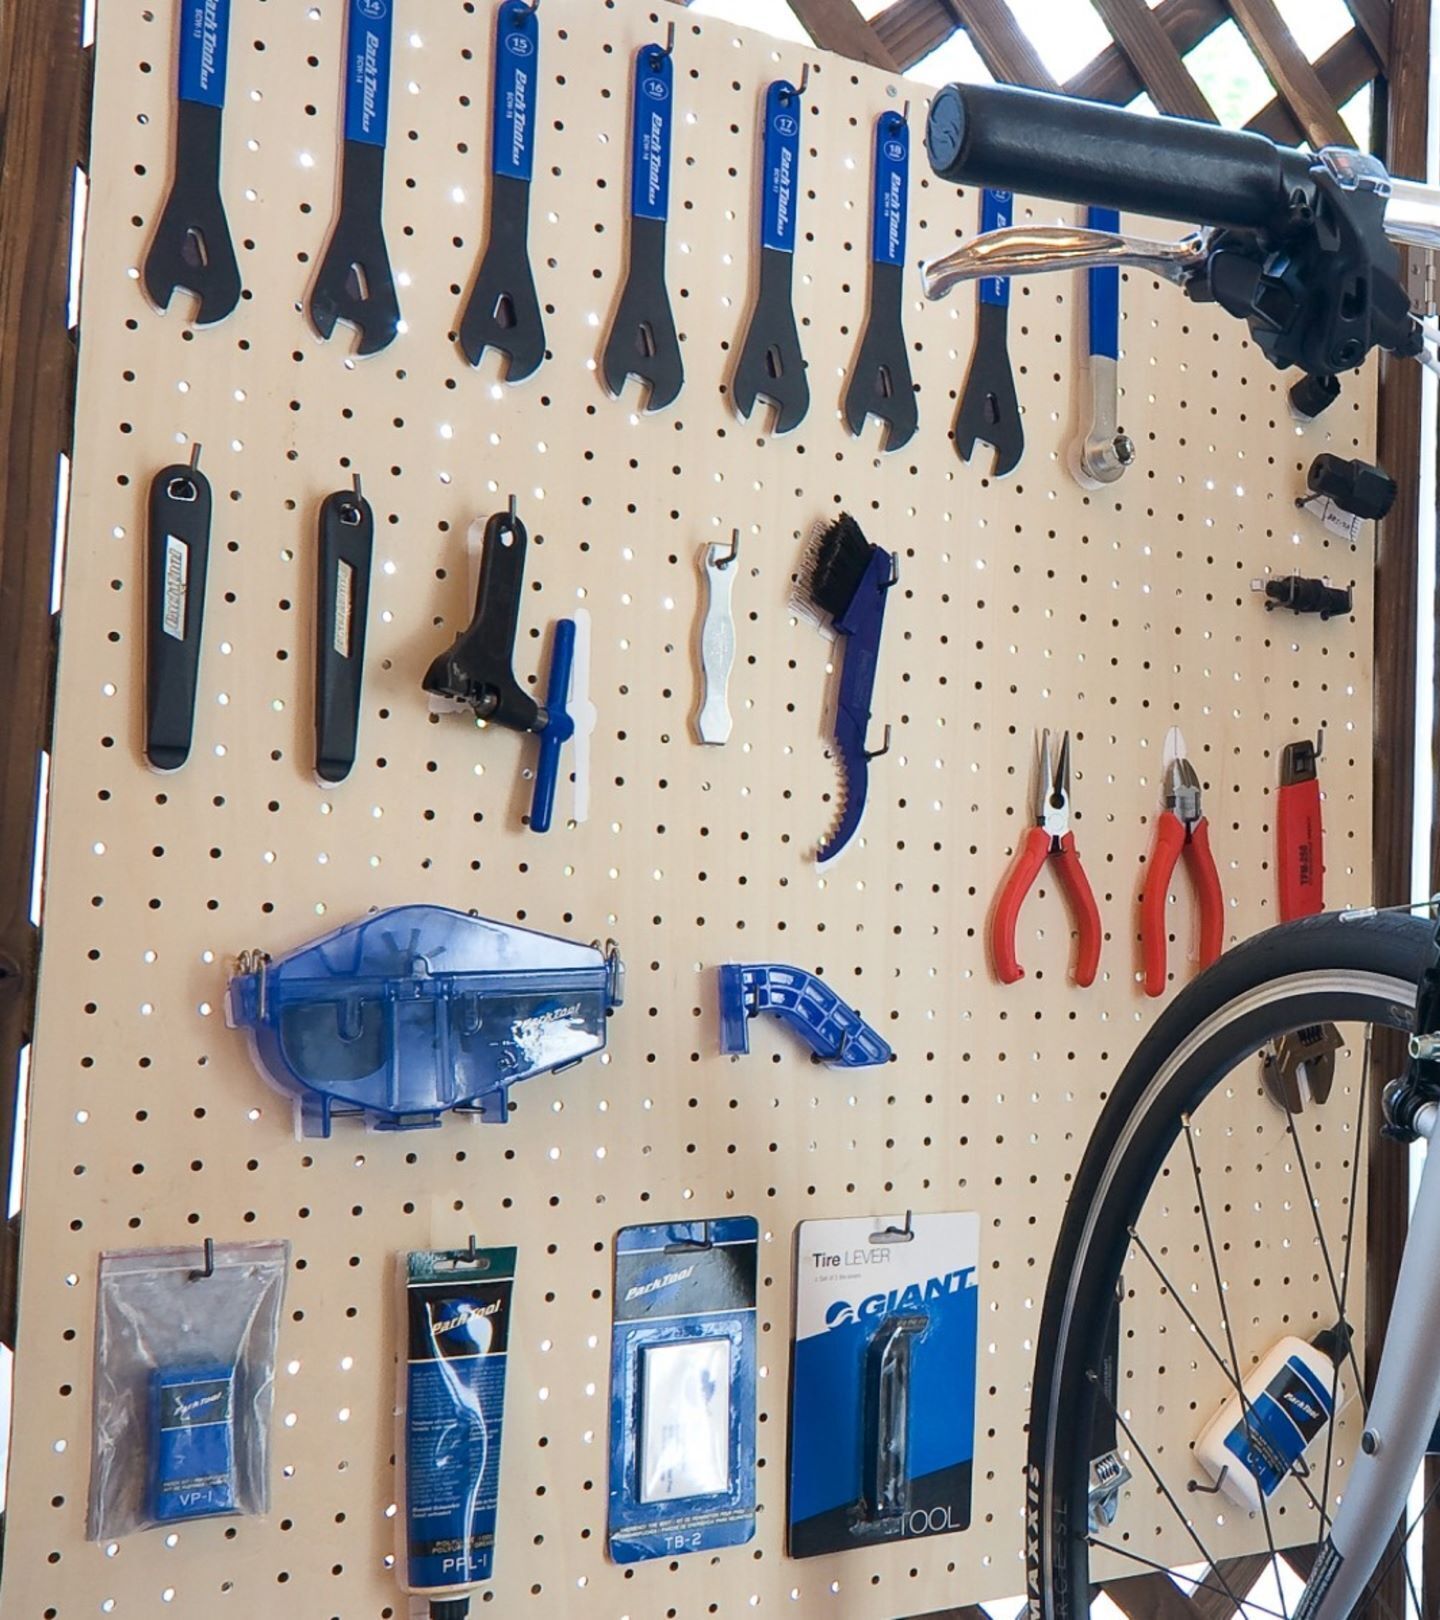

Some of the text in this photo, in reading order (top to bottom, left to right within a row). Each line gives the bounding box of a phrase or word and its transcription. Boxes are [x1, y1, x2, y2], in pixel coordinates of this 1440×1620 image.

[512, 38, 528, 49] 15
[649, 81, 664, 93] 16
[779, 118, 793, 130] 17
[888, 144, 902, 156] 18
[813, 1248, 891, 1268] Tire LEVER
[858, 1266, 977, 1322] GIANT
[179, 1490, 213, 1507] VP-1
[899, 1506, 961, 1536] TOOL
[665, 1532, 702, 1550] TB-2
[1027, 1463, 1041, 1620] MAXXIS
